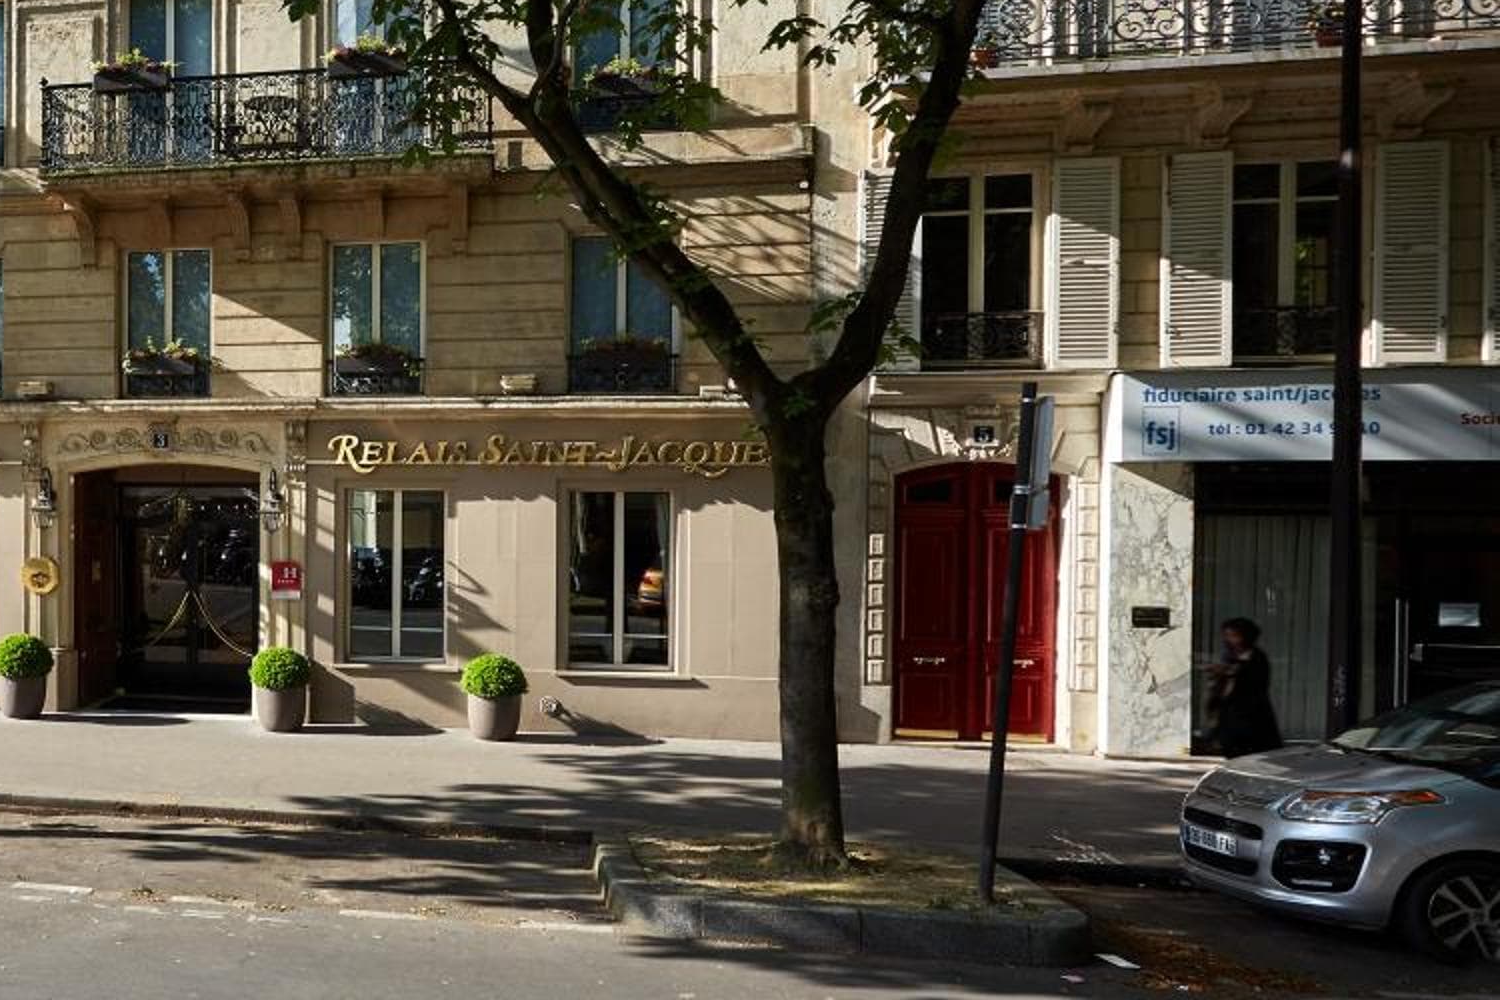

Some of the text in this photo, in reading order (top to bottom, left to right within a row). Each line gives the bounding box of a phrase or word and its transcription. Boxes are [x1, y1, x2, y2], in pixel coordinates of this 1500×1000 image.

[1144, 382, 1381, 404] fiduciaire saint/jaces
[1146, 420, 1176, 450] fsj
[1245, 423, 1267, 435] 01
[1272, 422, 1295, 435] 42
[1301, 421, 1323, 434] 34
[328, 434, 467, 473] RELAIS
[283, 567, 297, 579] H
